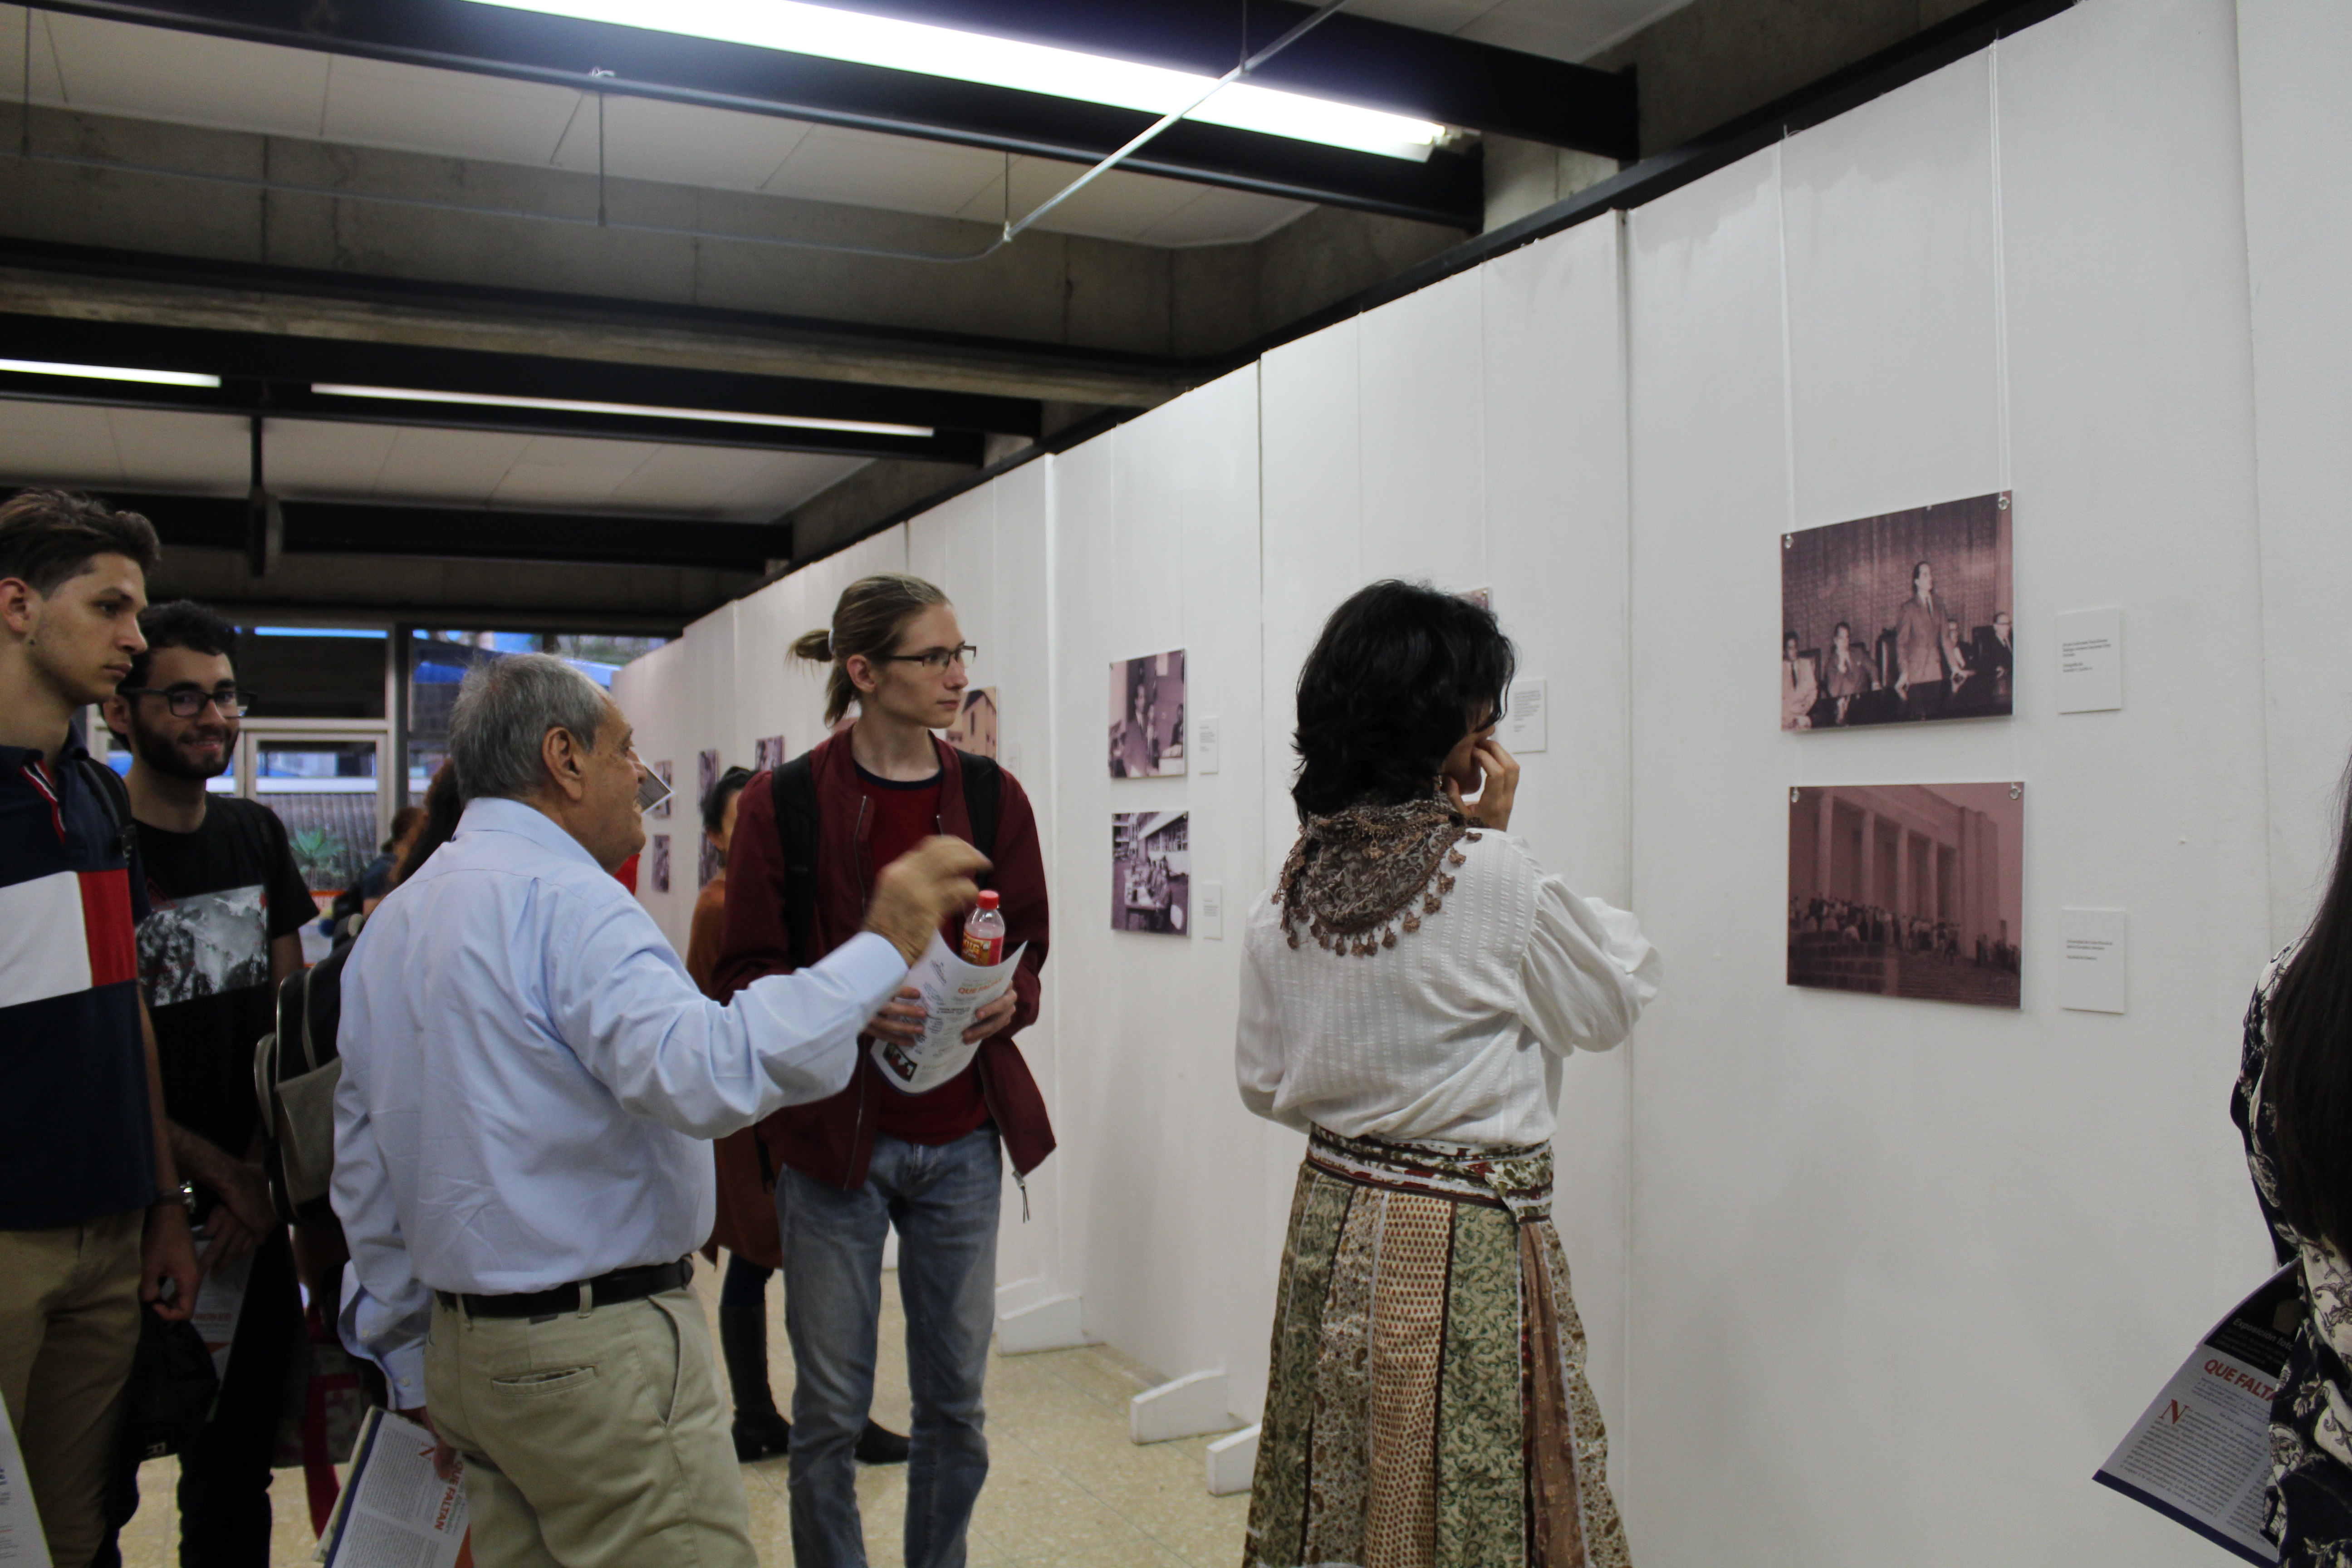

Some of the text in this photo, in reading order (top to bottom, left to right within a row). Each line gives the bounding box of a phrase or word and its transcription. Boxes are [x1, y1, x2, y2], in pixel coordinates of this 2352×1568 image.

[2233, 1318, 2276, 1342] Exposición
[2204, 1359, 2238, 1382] QUE
[449, 1460, 463, 1486] QUE
[434, 1486, 456, 1530] FALTAN
